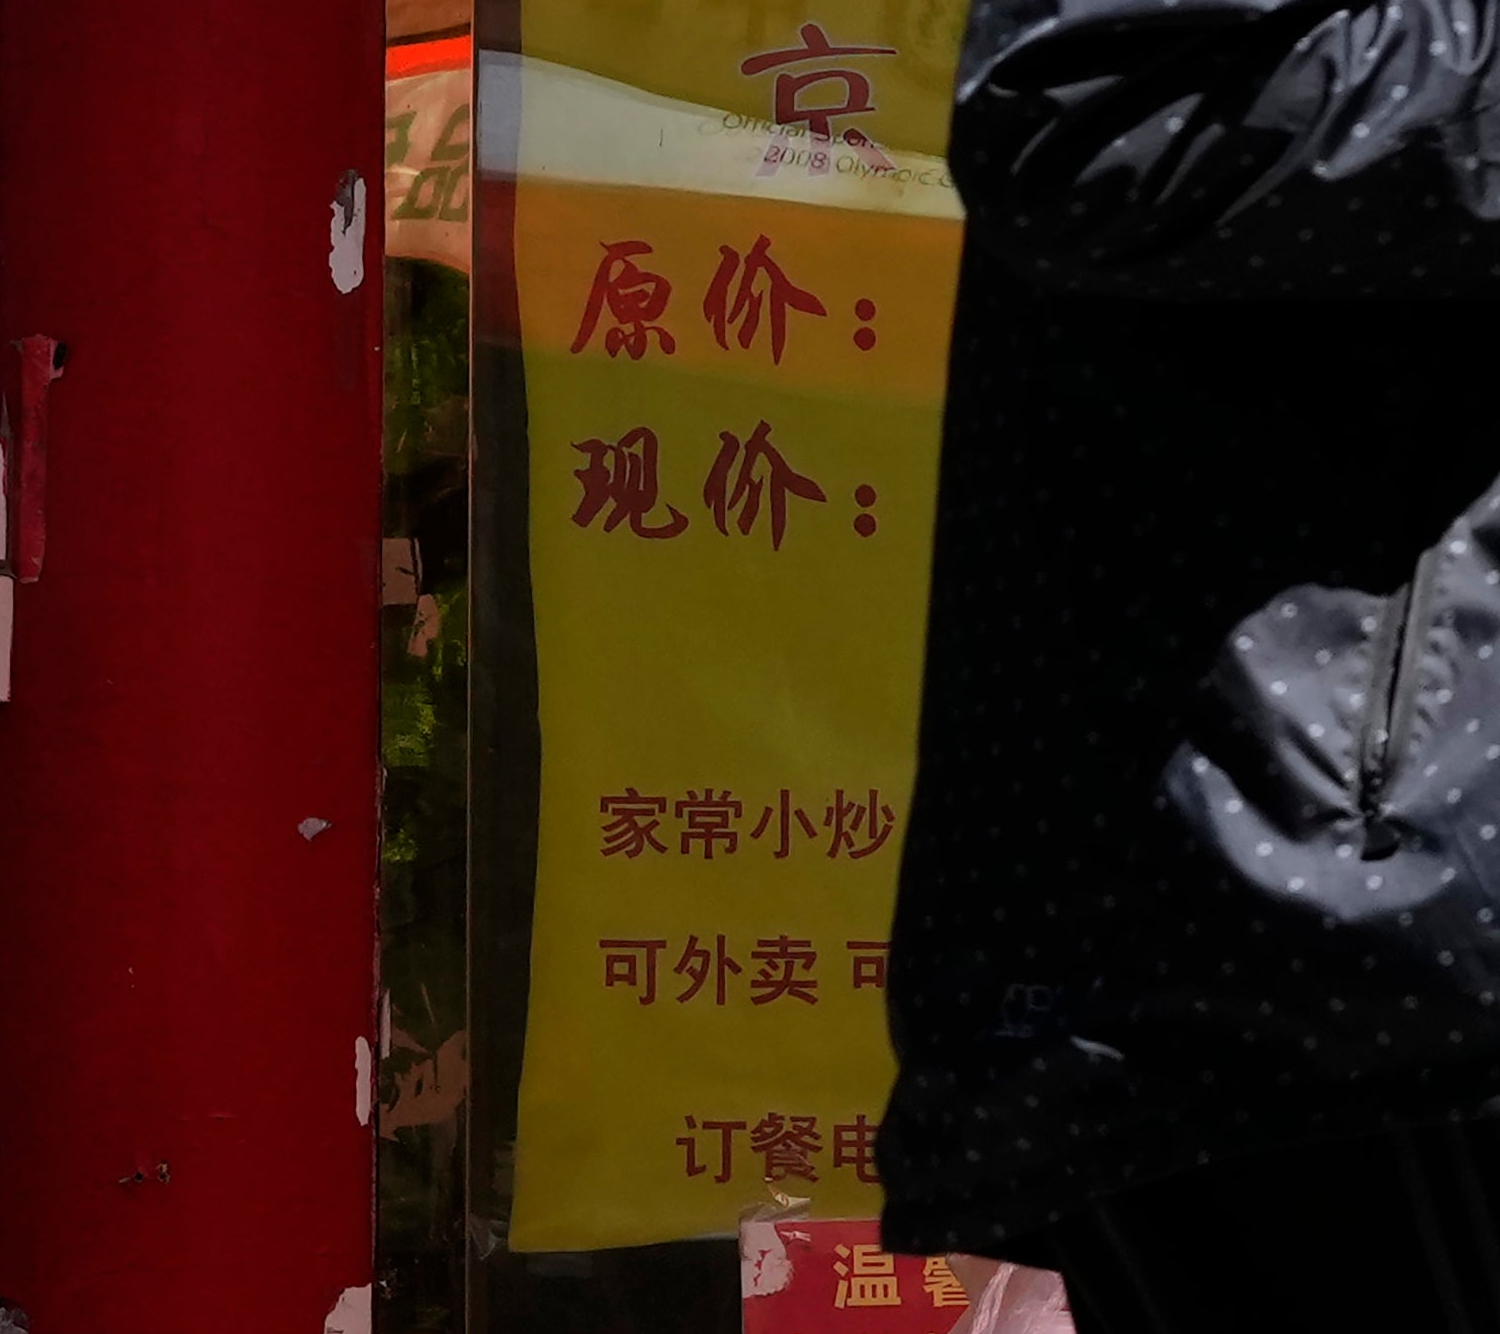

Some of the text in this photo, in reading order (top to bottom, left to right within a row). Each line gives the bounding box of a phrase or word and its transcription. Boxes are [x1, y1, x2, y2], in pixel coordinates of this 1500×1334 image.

[571, 234, 877, 366] 原价：
[571, 420, 877, 552] 现价：
[600, 787, 897, 860] 家常小炒
[599, 934, 820, 1006] 可外卖
